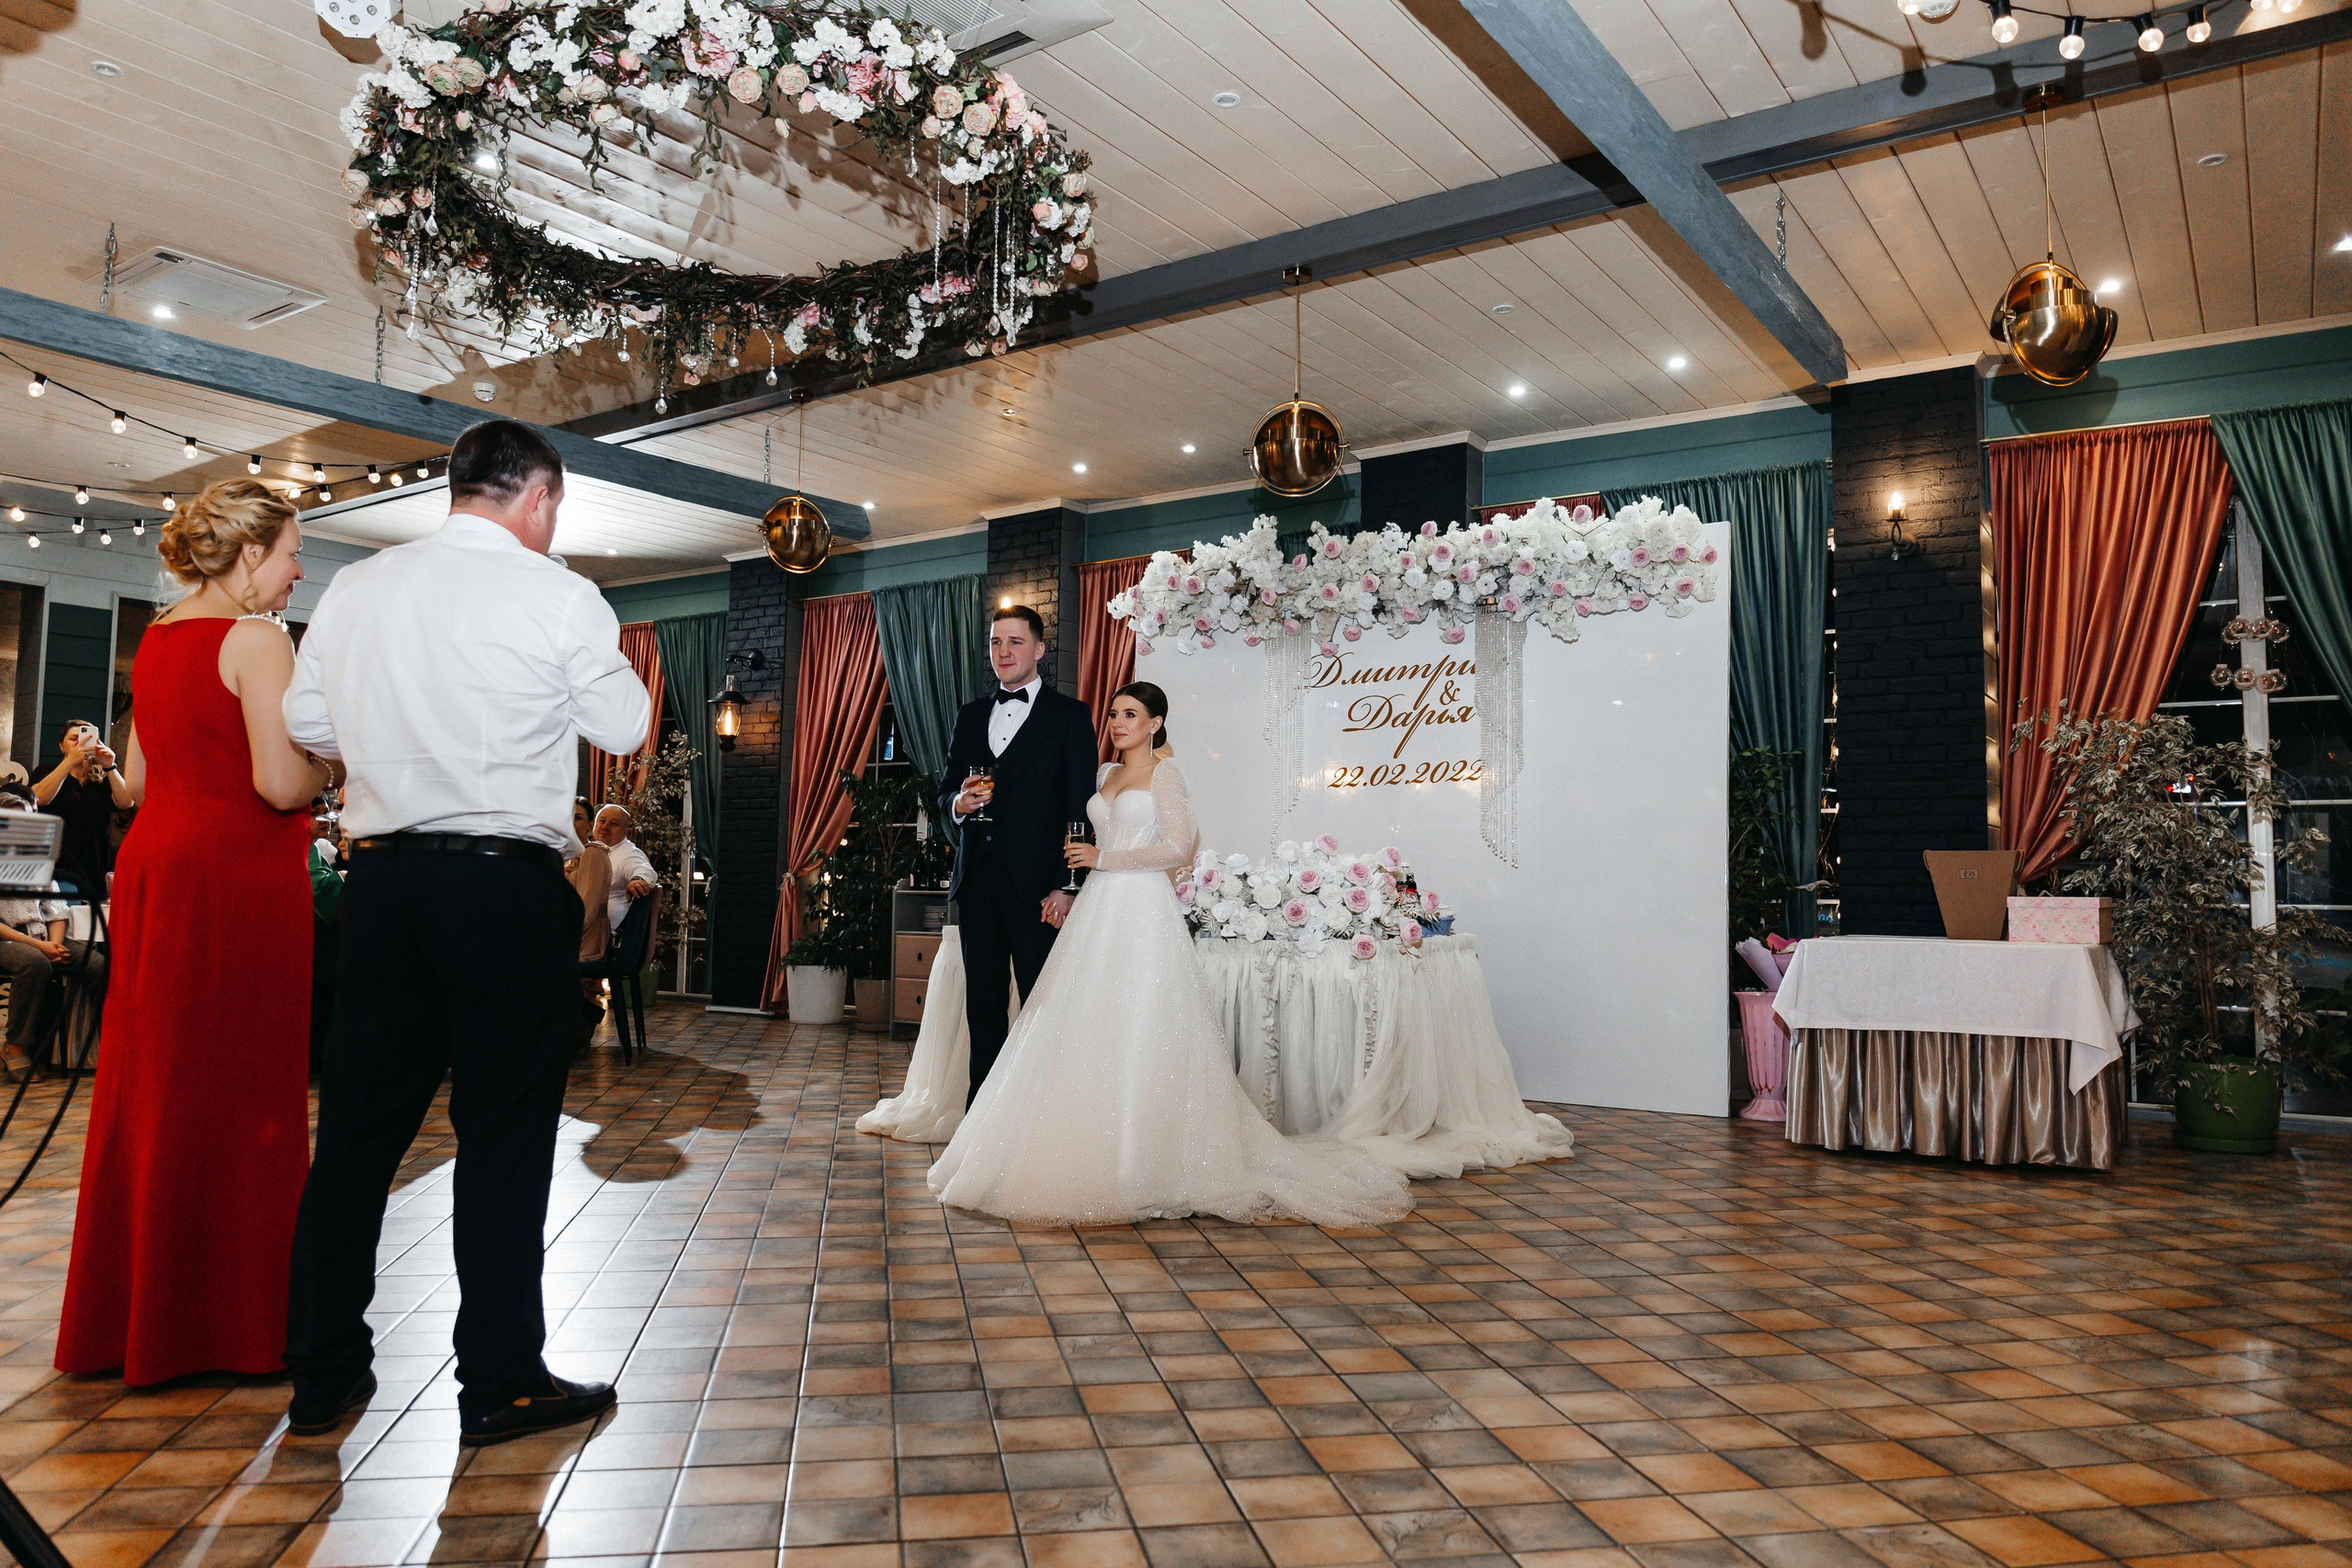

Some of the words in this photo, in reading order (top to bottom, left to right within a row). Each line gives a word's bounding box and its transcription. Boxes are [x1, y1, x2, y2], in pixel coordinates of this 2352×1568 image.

[1310, 651, 1476, 710] Дмитри
[1439, 680, 1461, 706] &
[1341, 693, 1477, 759] Дарья
[1327, 759, 1482, 789] 22.02.2022
